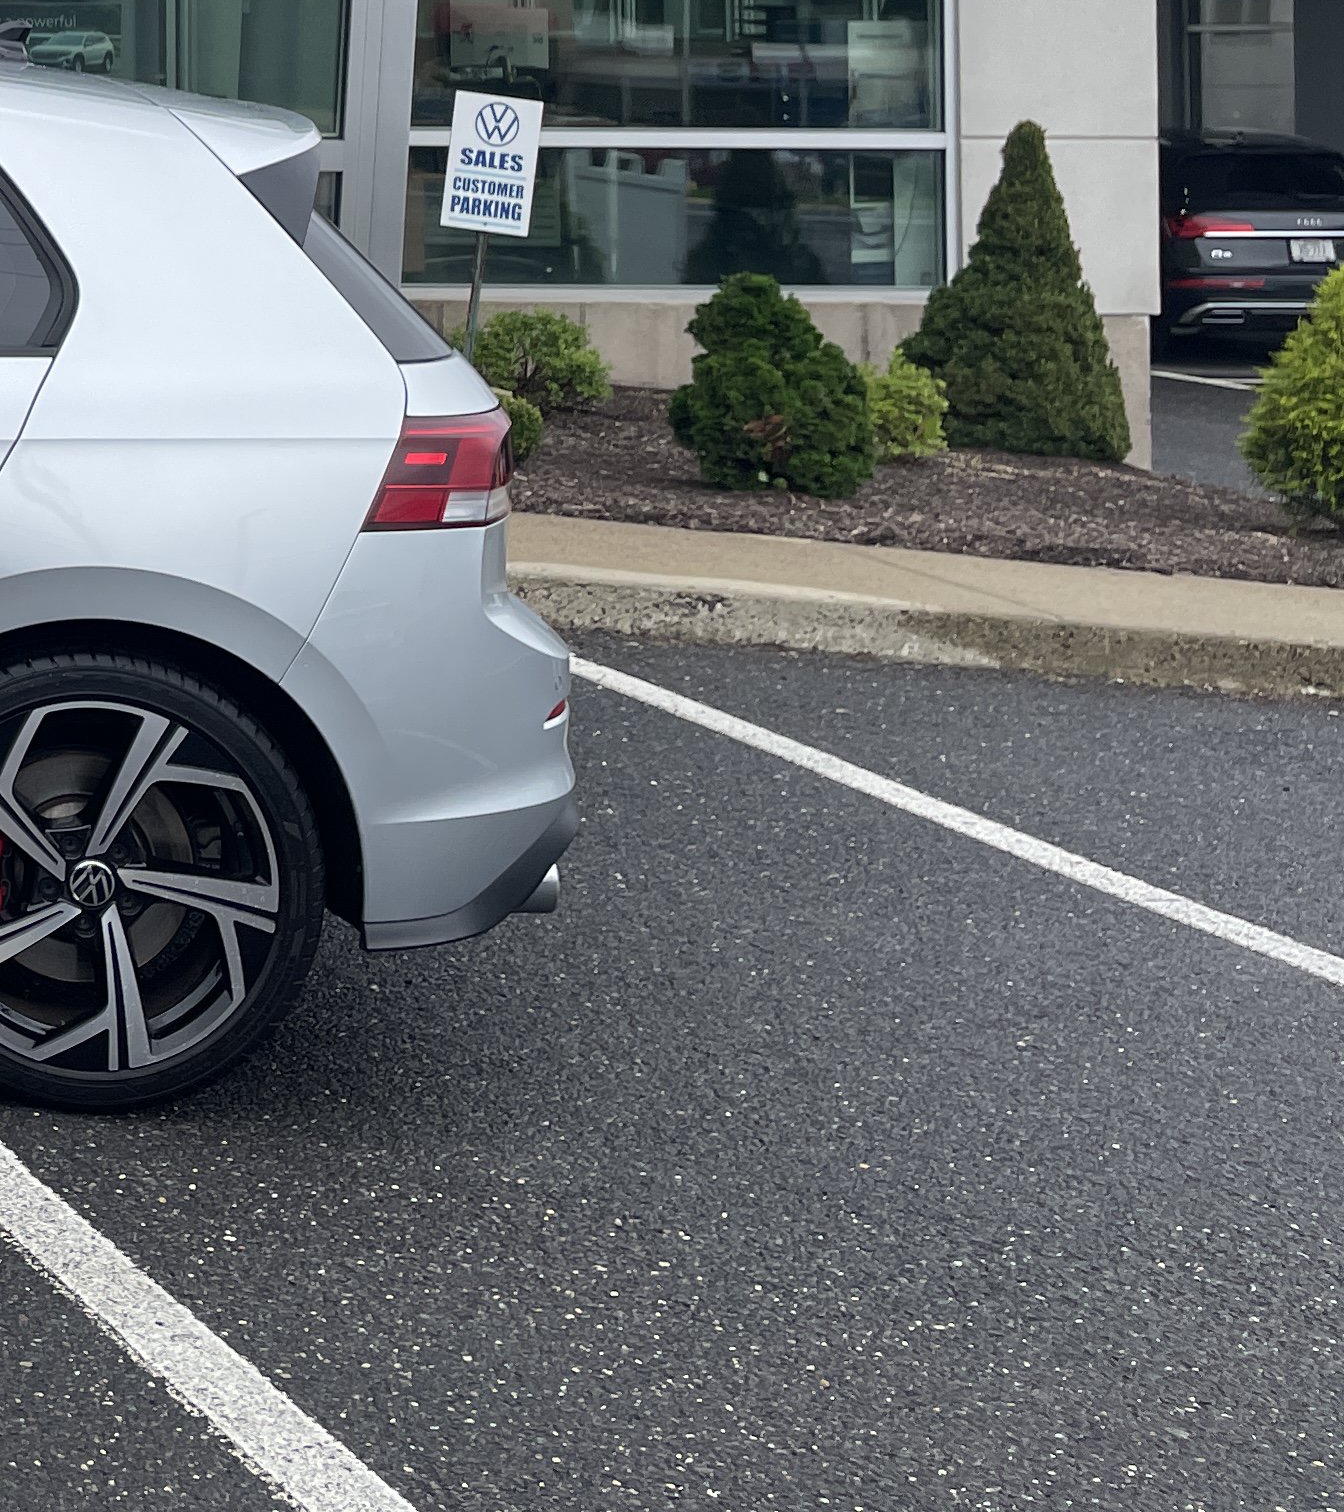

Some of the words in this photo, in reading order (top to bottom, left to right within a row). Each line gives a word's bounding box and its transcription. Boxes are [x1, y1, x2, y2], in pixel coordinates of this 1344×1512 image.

[460, 147, 524, 172] SALES
[452, 176, 525, 200] CUSTOMER
[450, 195, 522, 222] PARKING
